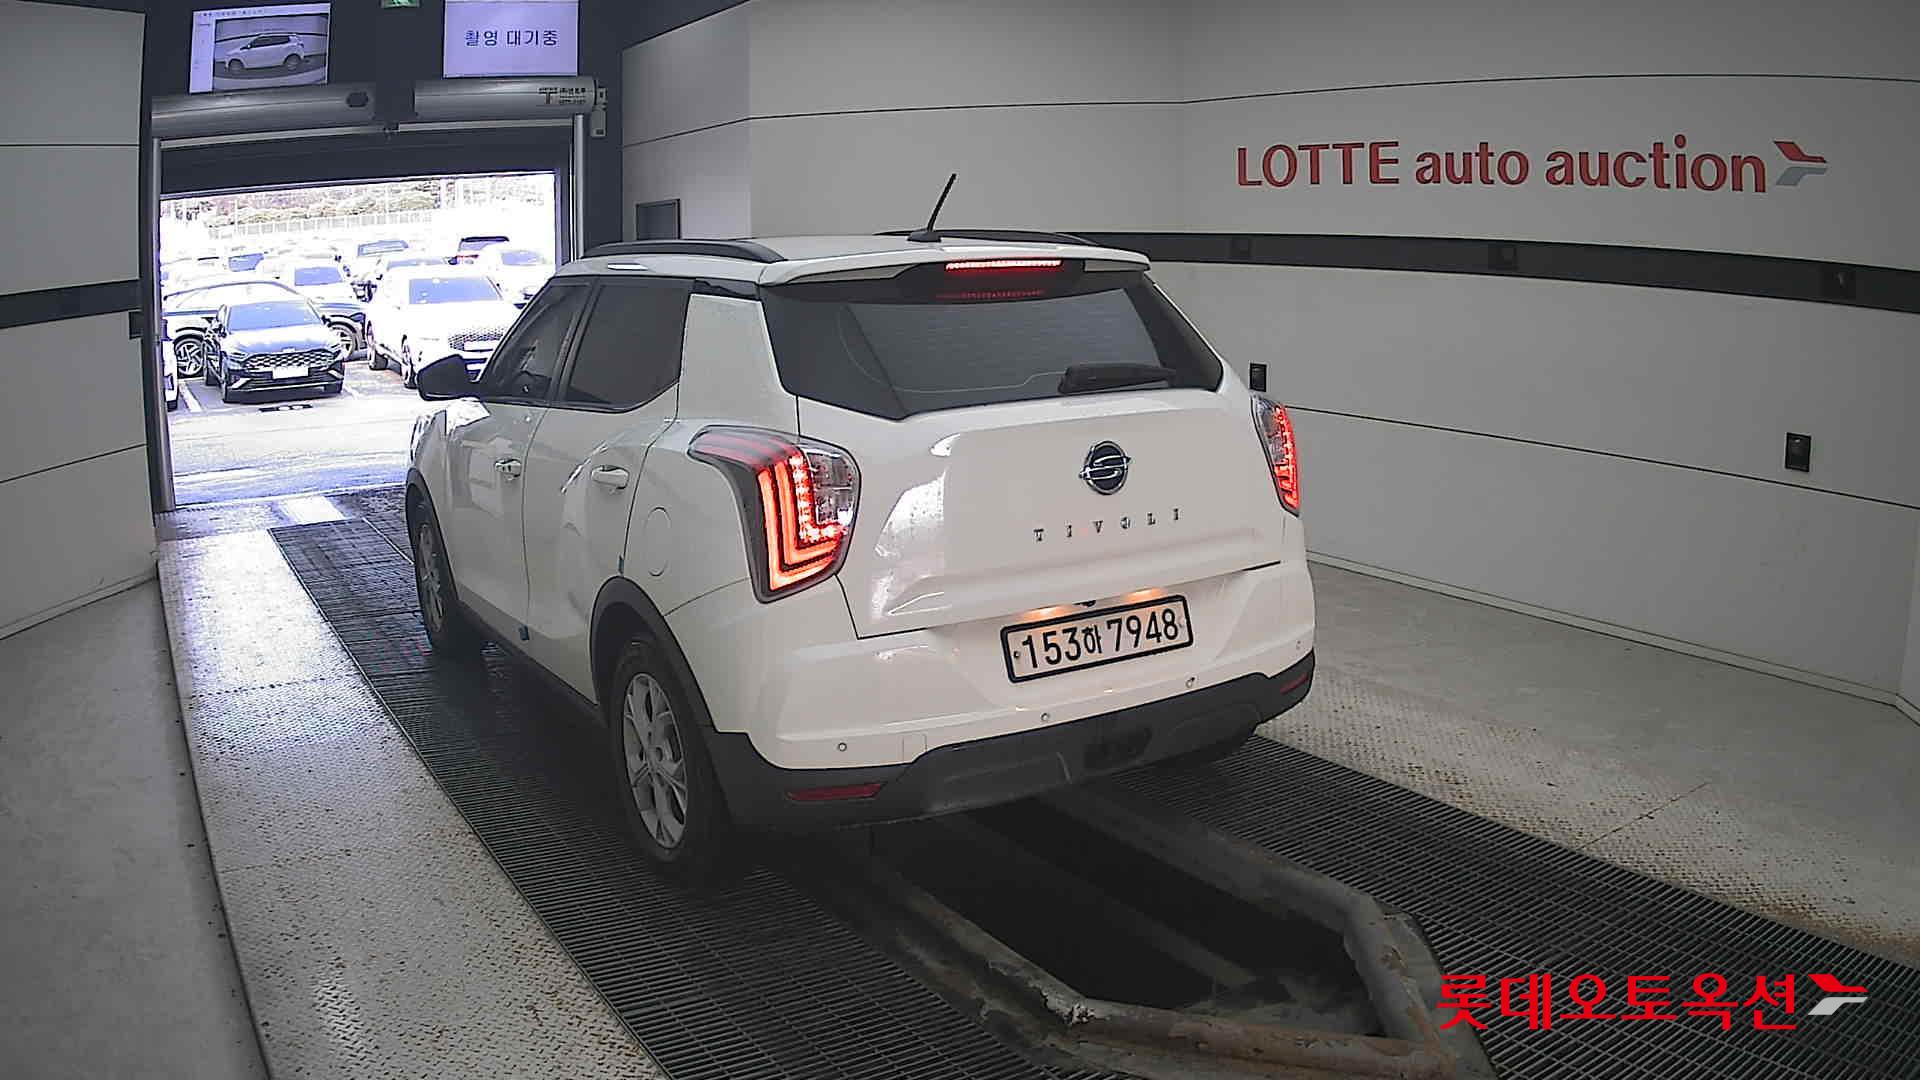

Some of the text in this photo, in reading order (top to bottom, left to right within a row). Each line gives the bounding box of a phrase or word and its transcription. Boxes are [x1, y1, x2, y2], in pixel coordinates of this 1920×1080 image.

[465, 30, 557, 47] 촬영 대기중
[1237, 134, 1767, 193] LOTTE auto auction
[1033, 508, 1181, 542] TIVOLI
